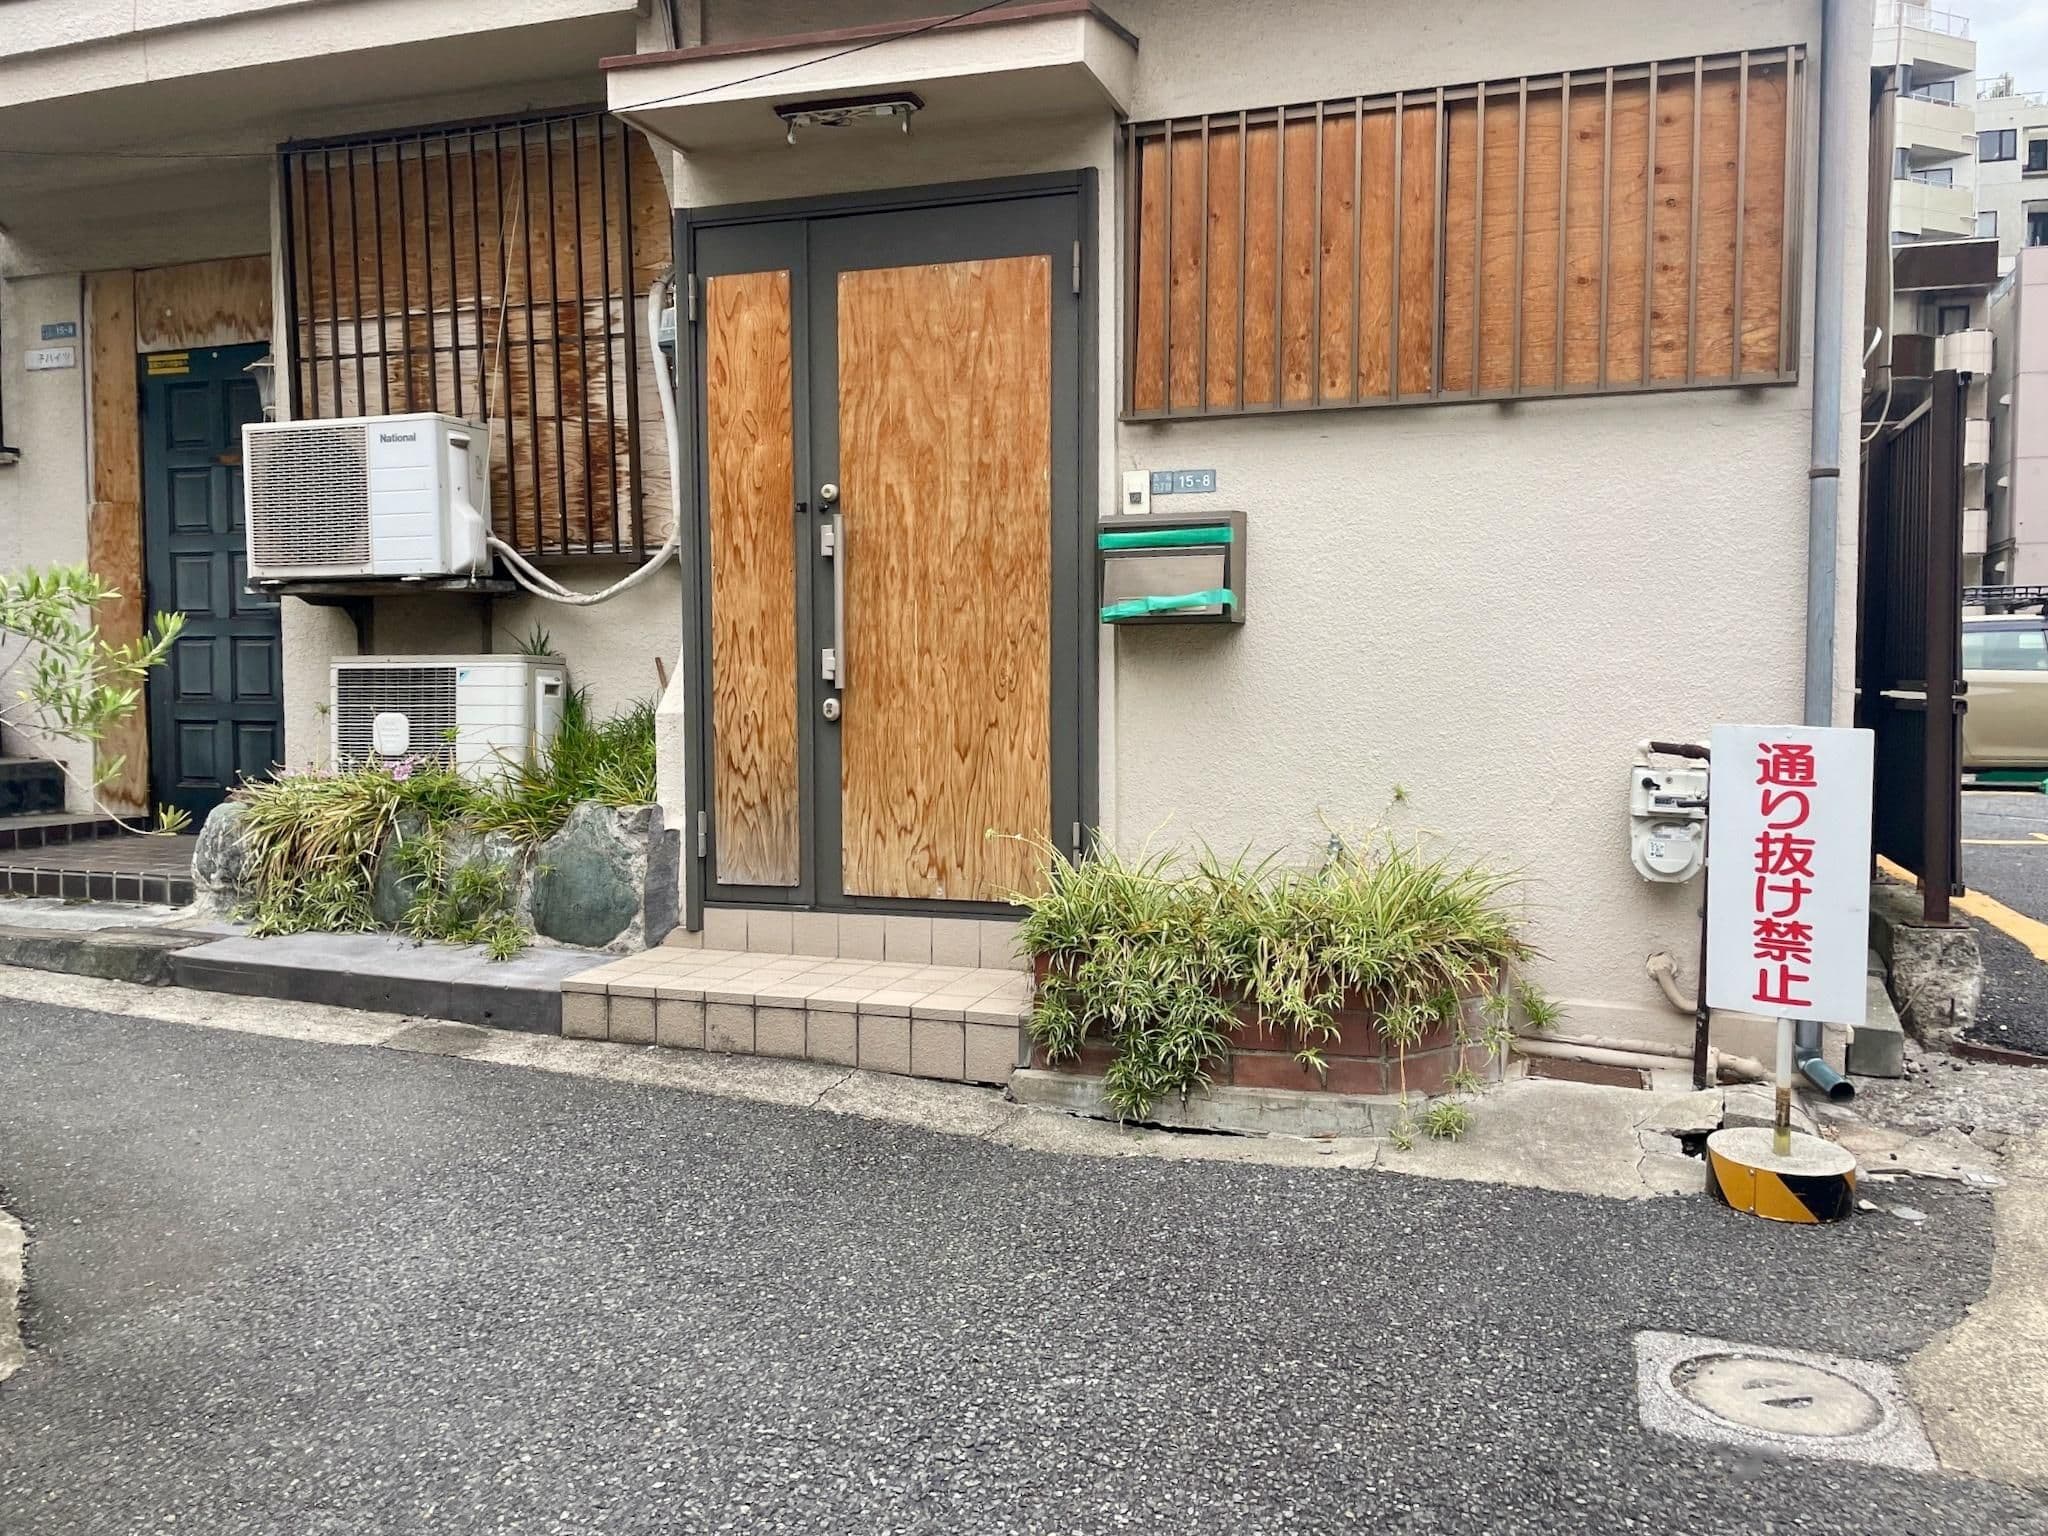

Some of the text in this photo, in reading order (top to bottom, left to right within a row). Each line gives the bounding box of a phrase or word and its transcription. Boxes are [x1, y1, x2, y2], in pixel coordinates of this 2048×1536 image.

[379, 432, 417, 443] National
[1179, 474, 1210, 488] 15-8
[1752, 742, 1818, 1007] 通り抜け禁止
